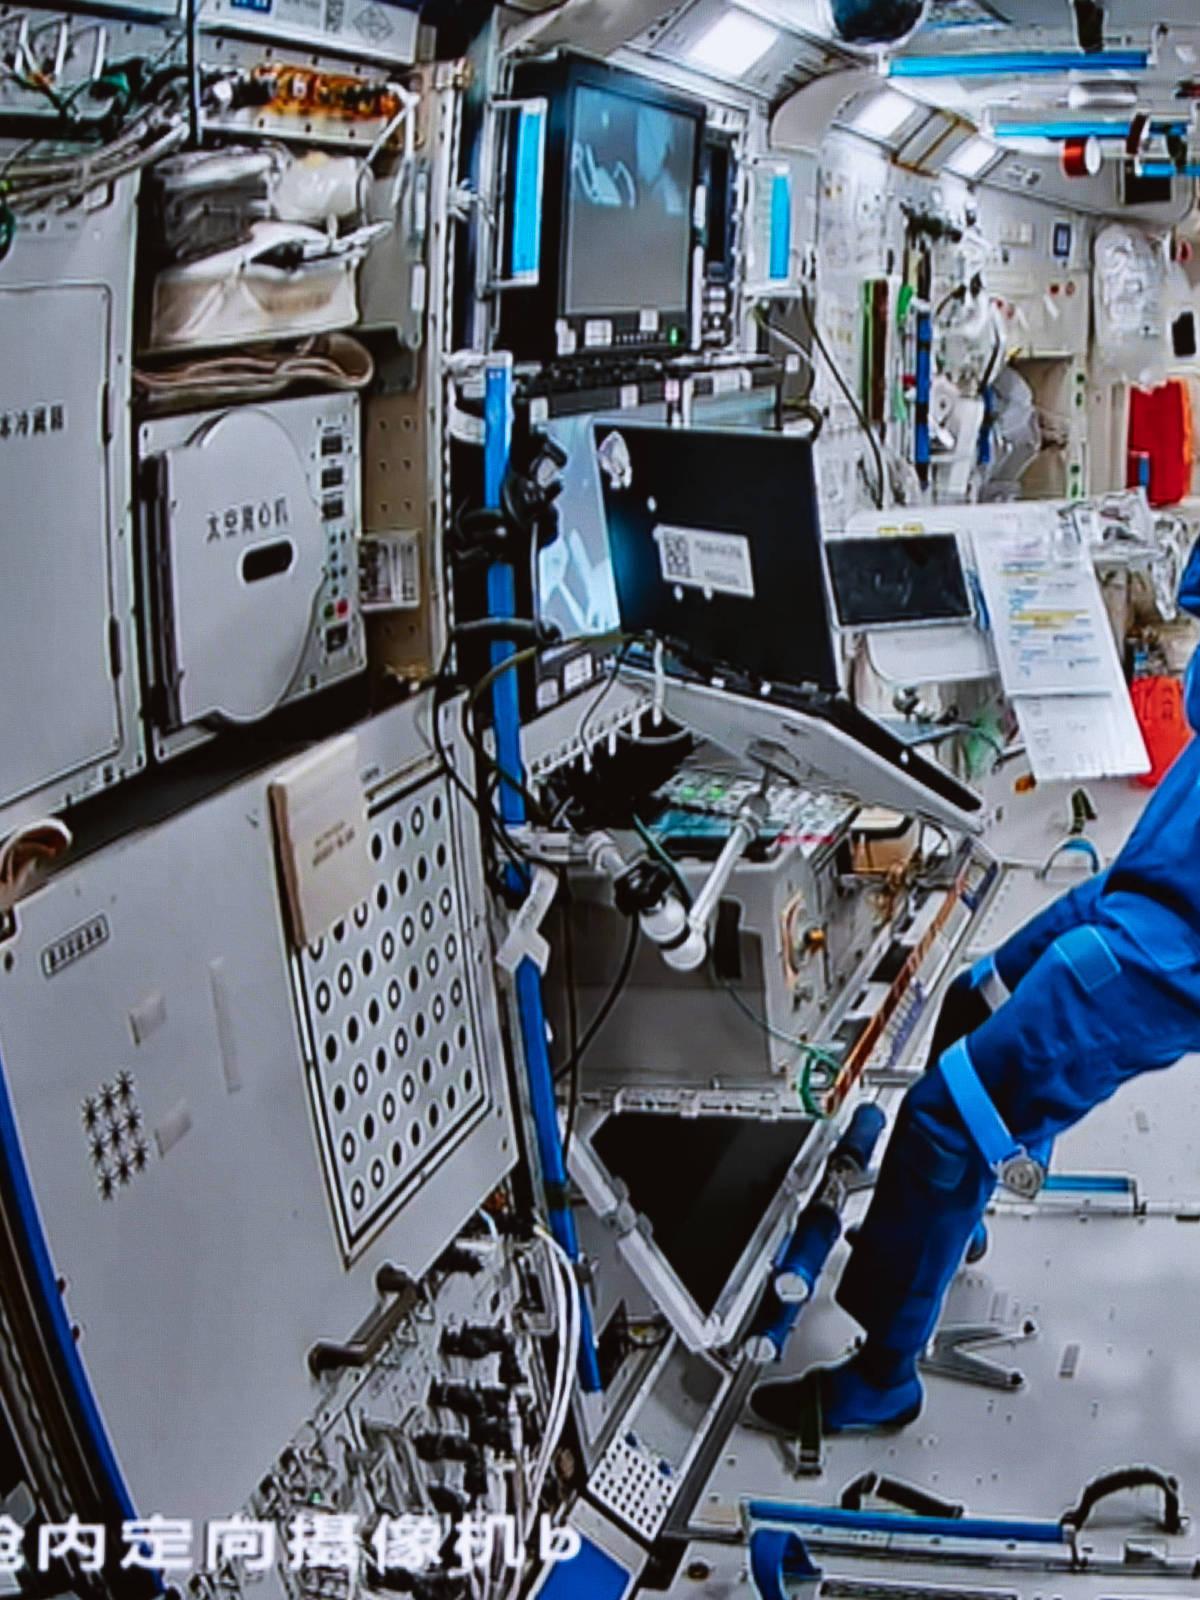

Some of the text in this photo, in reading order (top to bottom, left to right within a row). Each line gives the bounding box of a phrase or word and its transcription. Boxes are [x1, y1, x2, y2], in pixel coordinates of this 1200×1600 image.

[206, 497, 289, 543] 太空离心机
